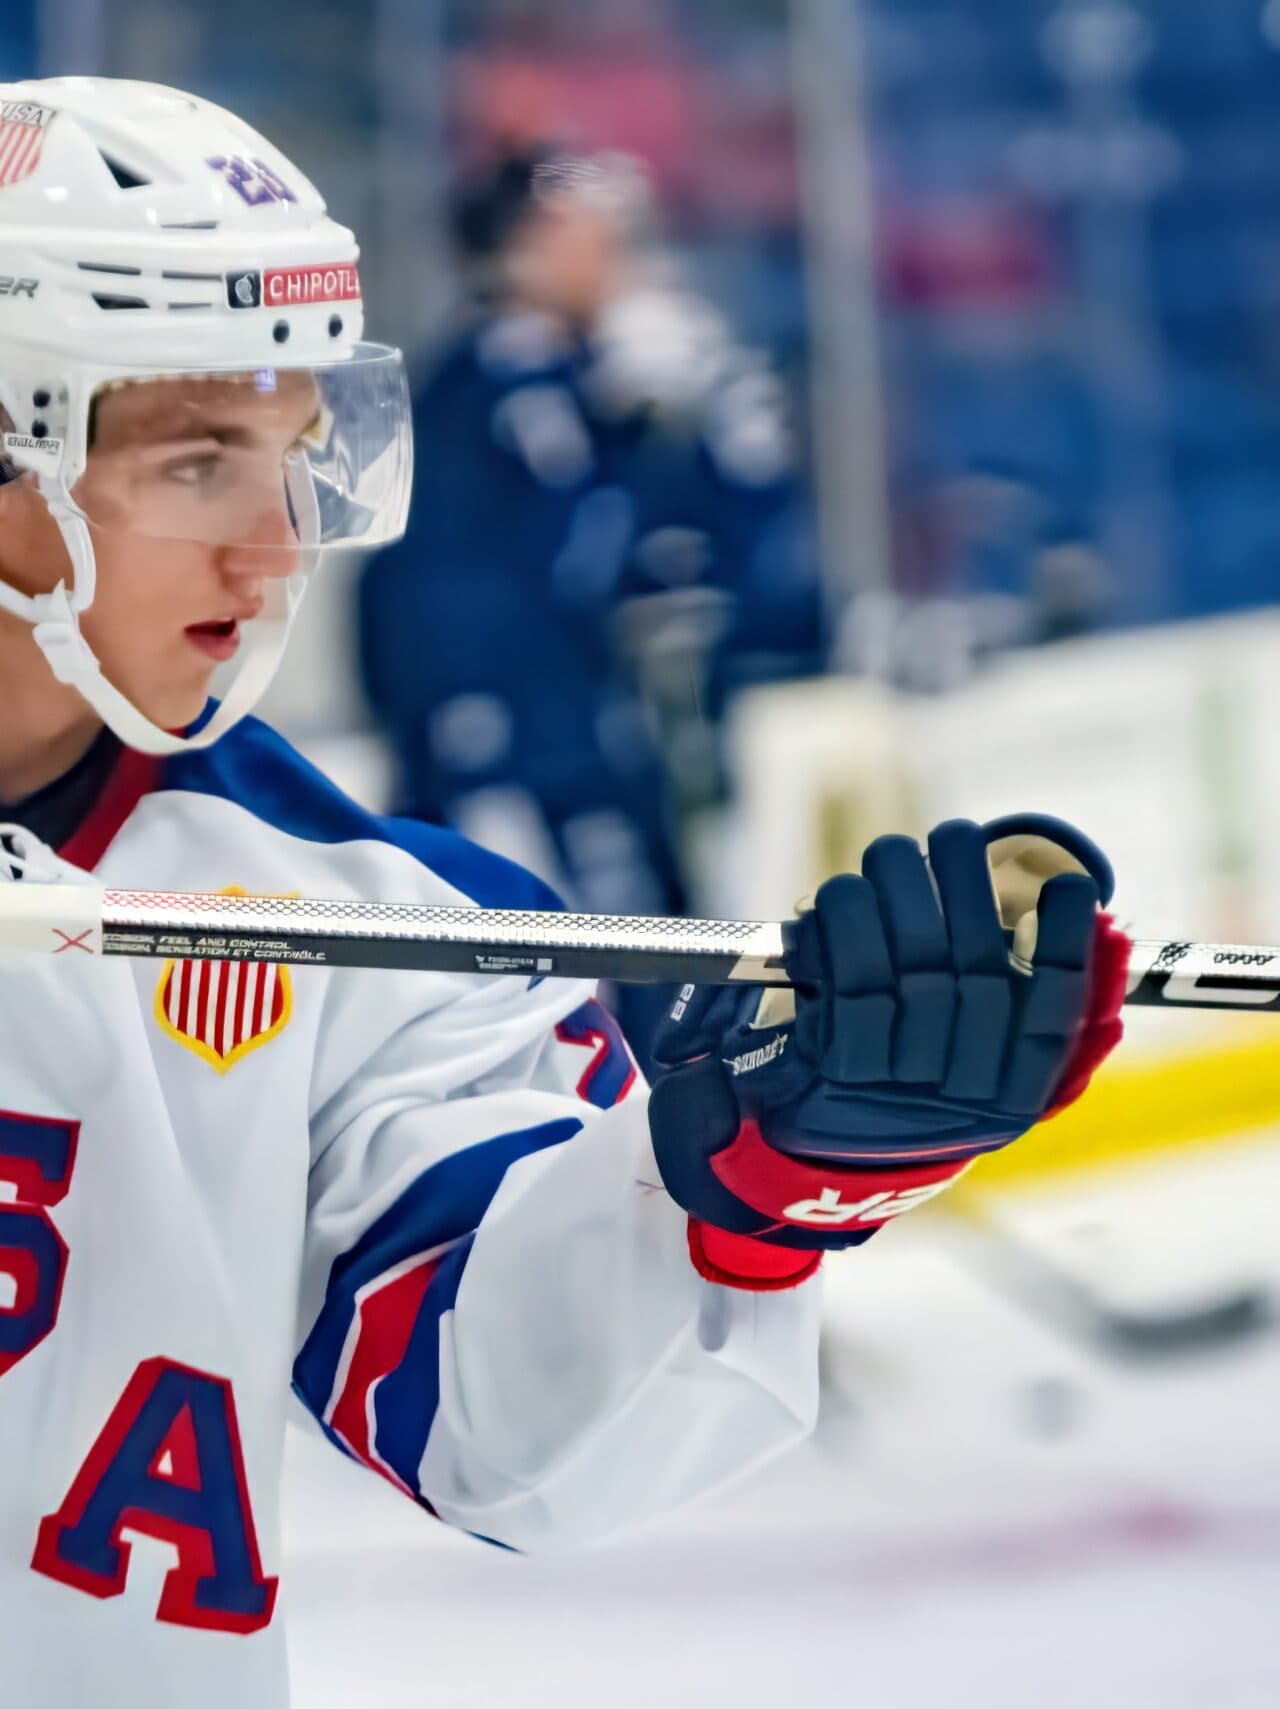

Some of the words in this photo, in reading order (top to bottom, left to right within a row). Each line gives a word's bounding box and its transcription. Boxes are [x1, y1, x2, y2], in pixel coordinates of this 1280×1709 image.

[0, 102, 43, 127] USA
[197, 937, 227, 948] AND
[229, 939, 292, 950] CONTROL
[233, 948, 252, 958] ET
